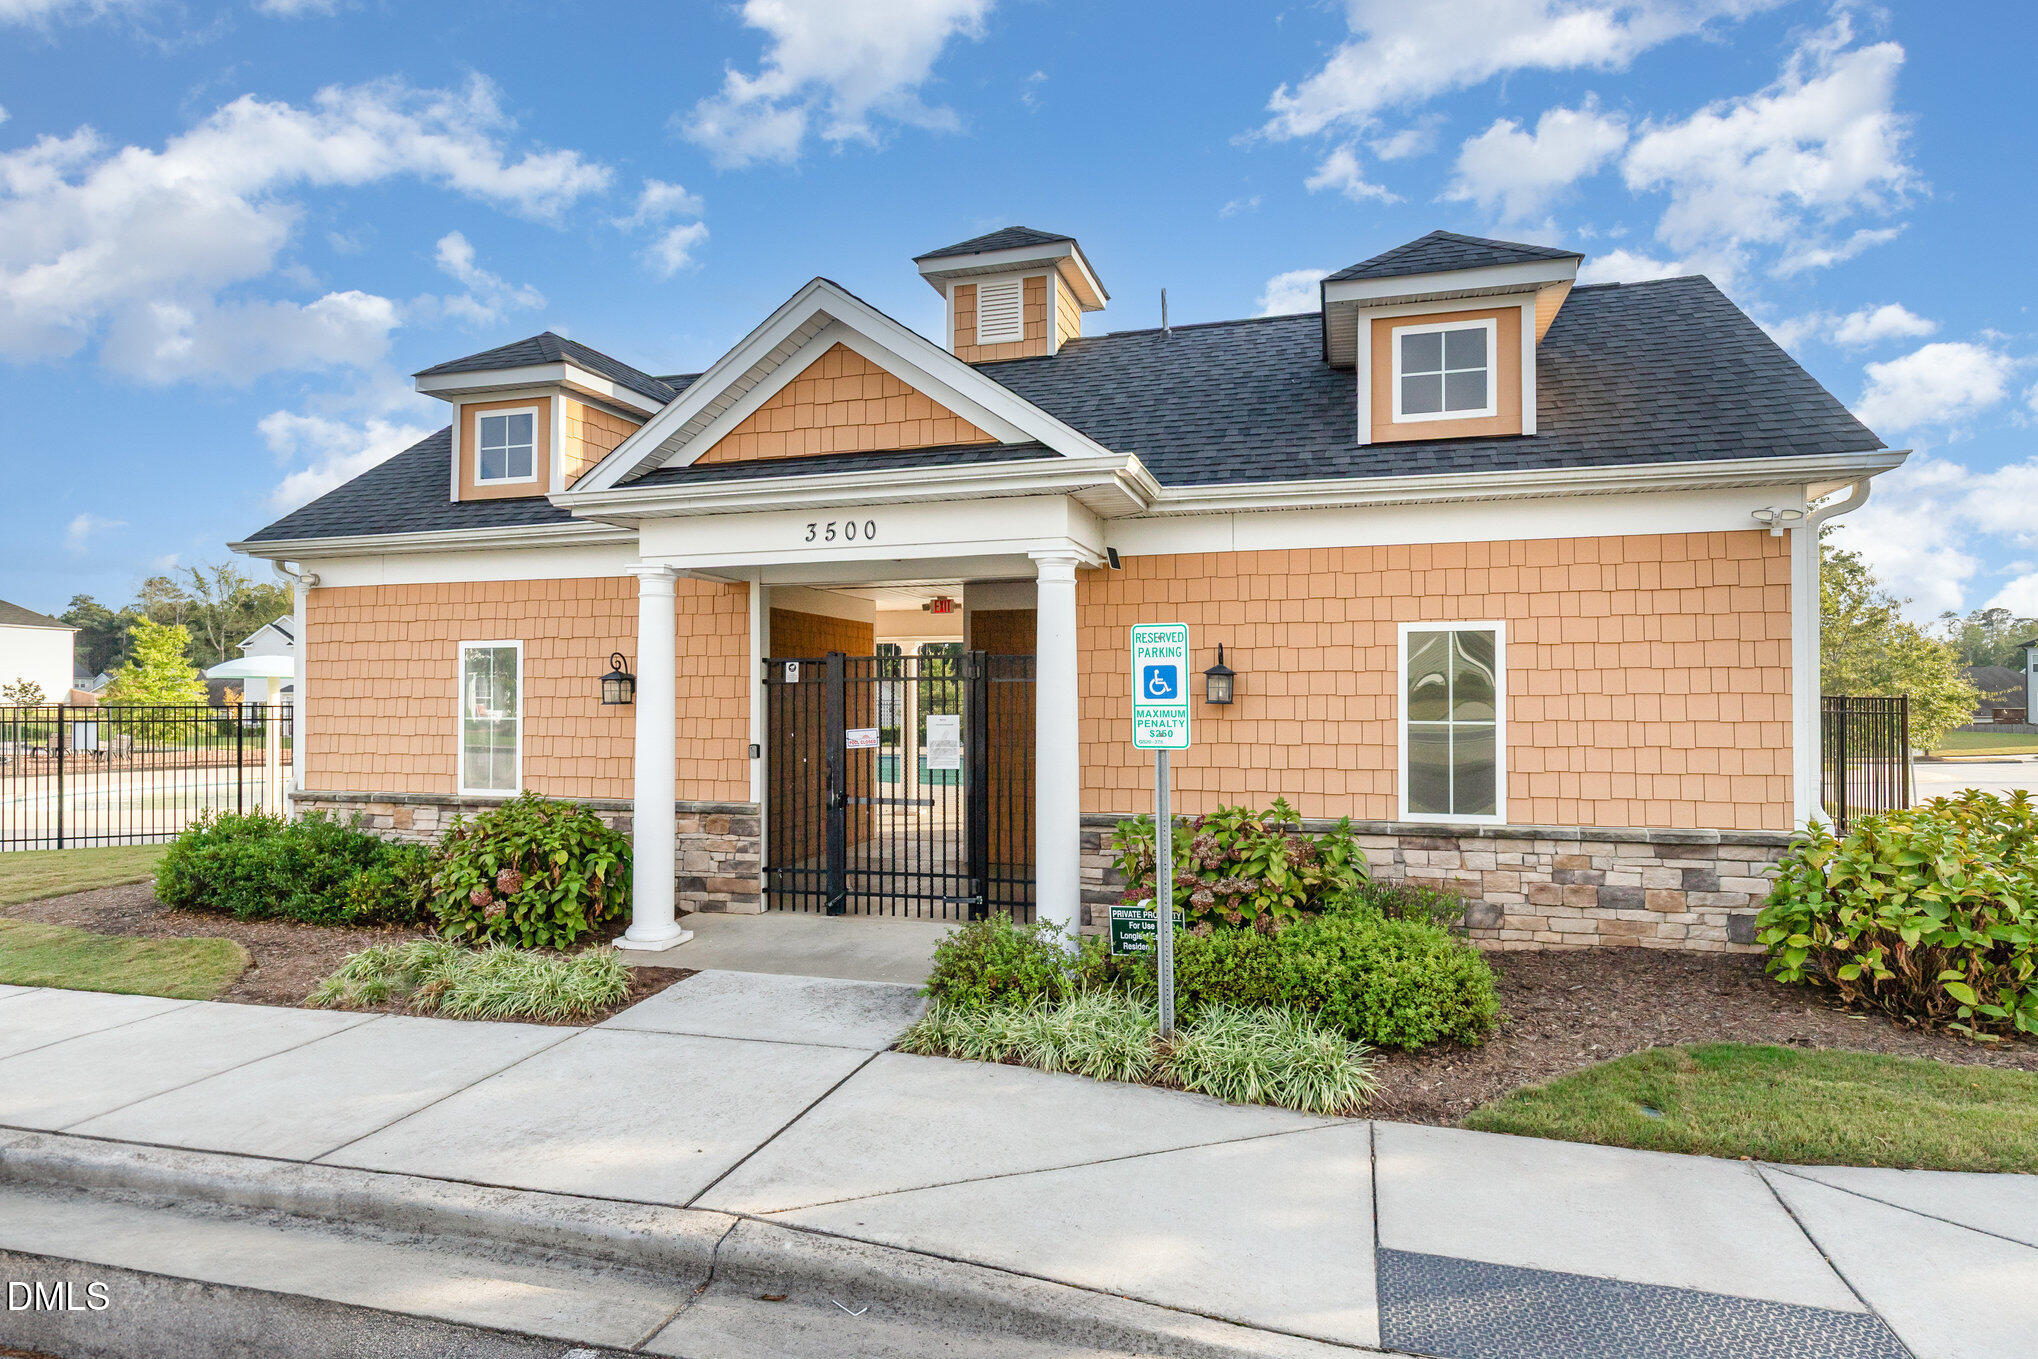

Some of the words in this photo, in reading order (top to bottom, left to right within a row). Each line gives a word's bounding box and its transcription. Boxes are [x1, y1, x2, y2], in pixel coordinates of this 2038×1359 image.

[805, 519, 877, 542] 3500
[934, 600, 951, 613] EXIT
[1135, 632, 1184, 643] RESERVED
[1138, 647, 1182, 658] PARKING
[1136, 710, 1186, 718] MAXIMUM
[1137, 719, 1185, 728] PENALTY
[1112, 910, 1141, 918] PRIVATE
[1143, 910, 1181, 920] PROTY
[1128, 921, 1140, 929] For
[1142, 922, 1155, 930] Use
